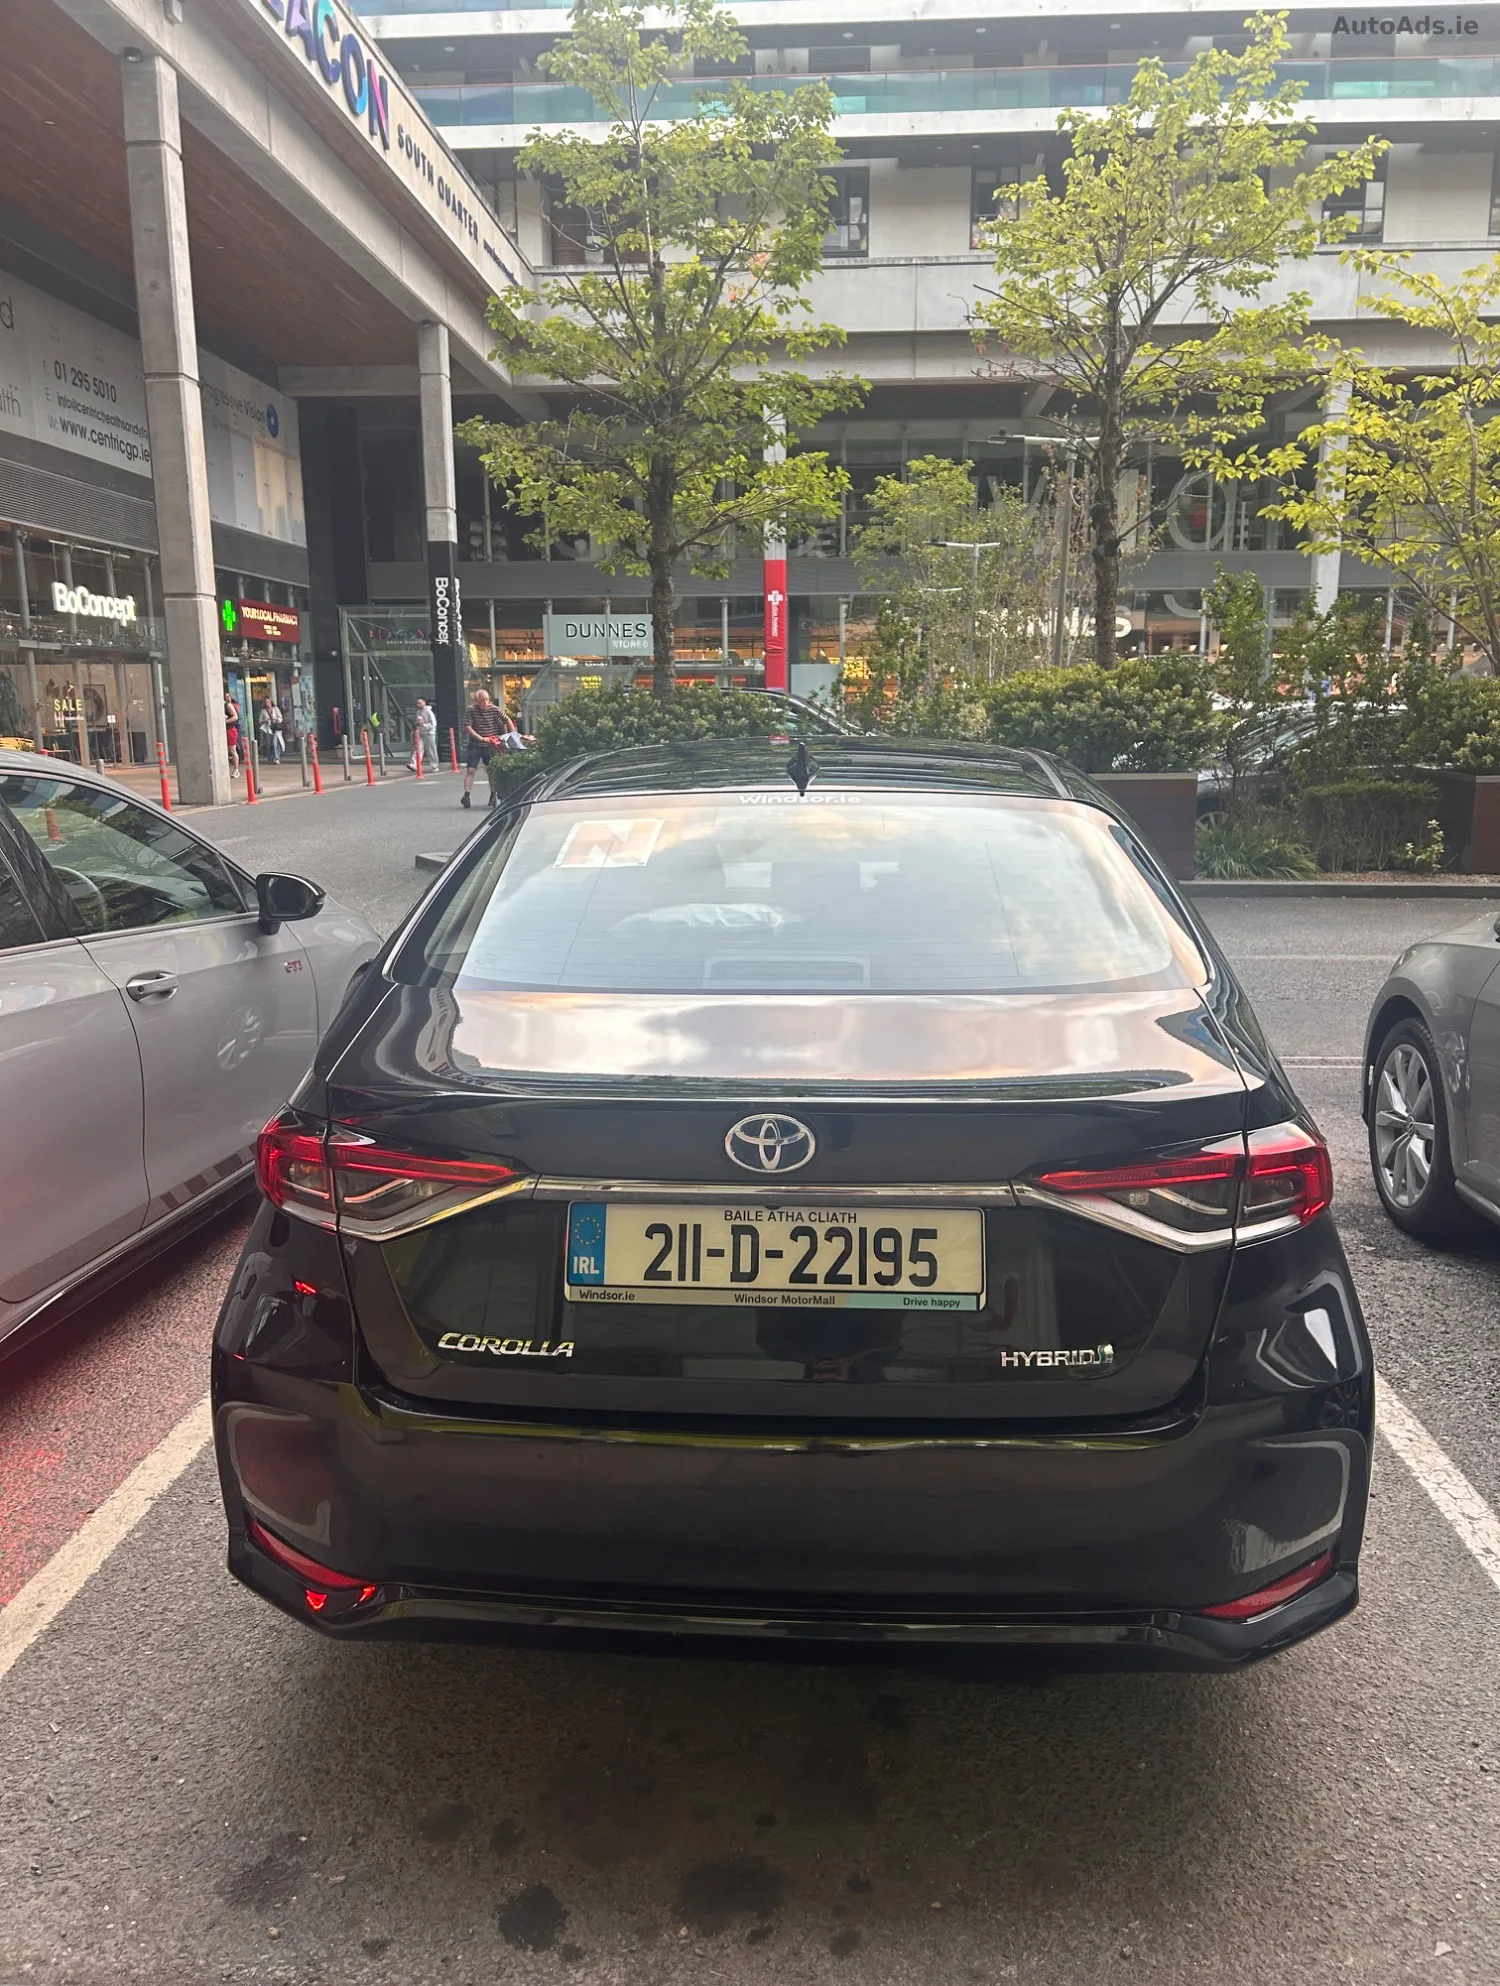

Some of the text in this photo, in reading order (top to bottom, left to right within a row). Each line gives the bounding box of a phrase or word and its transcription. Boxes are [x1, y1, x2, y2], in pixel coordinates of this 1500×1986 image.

[397, 123, 434, 186] SOUTH
[438, 175, 479, 243] QUARTER
[54, 360, 67, 383] 01
[71, 367, 91, 392] 295
[92, 376, 117, 403] 5010
[243, 399, 266, 424] Vision
[59, 417, 150, 463] www.centricgp.ie
[52, 582, 137, 627] BoConcept
[241, 606, 298, 626] YOUR LOCAL PHARMACY
[565, 622, 647, 638] DUNNES
[611, 640, 649, 649] STORES
[54, 699, 82, 711] SALE
[739, 794, 861, 805] Windsor.ie
[724, 1209, 857, 1224] BAILE ATHA CLIATH
[643, 1222, 938, 1288] 211-D-22195
[572, 1256, 600, 1275] IRL
[579, 1289, 635, 1301] Windsor.ie
[734, 1293, 836, 1306] Windsor MotorMall
[903, 1297, 961, 1309] Drive happy
[438, 1332, 576, 1358] COROLLA
[1000, 1349, 1095, 1367] HYBRID
